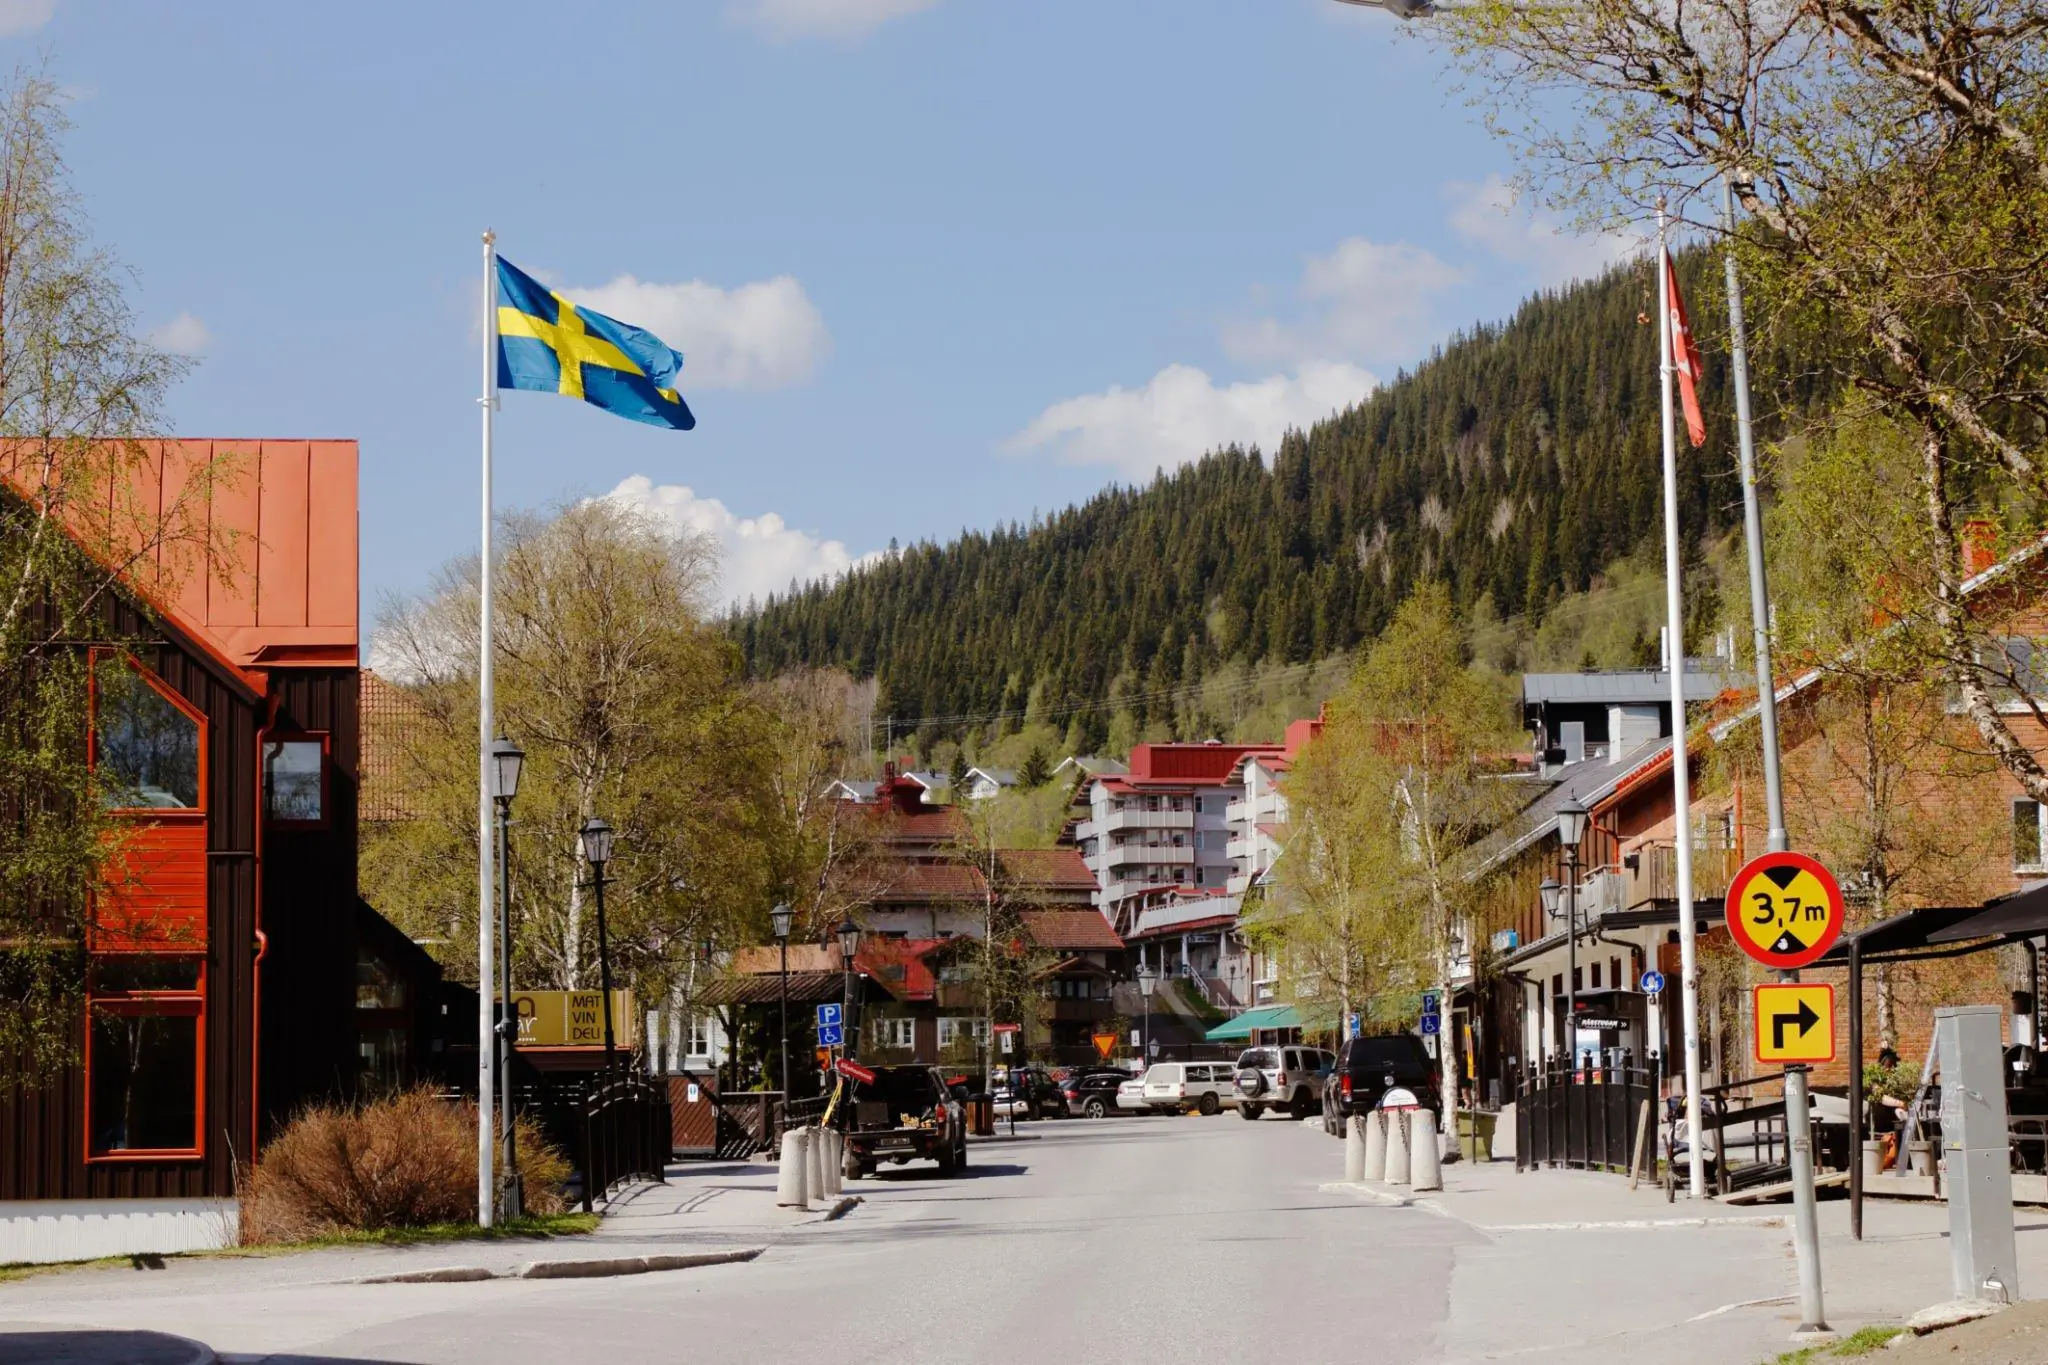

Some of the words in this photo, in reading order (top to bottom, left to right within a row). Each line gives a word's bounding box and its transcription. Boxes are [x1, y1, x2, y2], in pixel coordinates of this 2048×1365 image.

[572, 995, 601, 1008] MAT
[1426, 997, 1433, 1012] P
[572, 1011, 596, 1024] VIN
[824, 1006, 836, 1022] P
